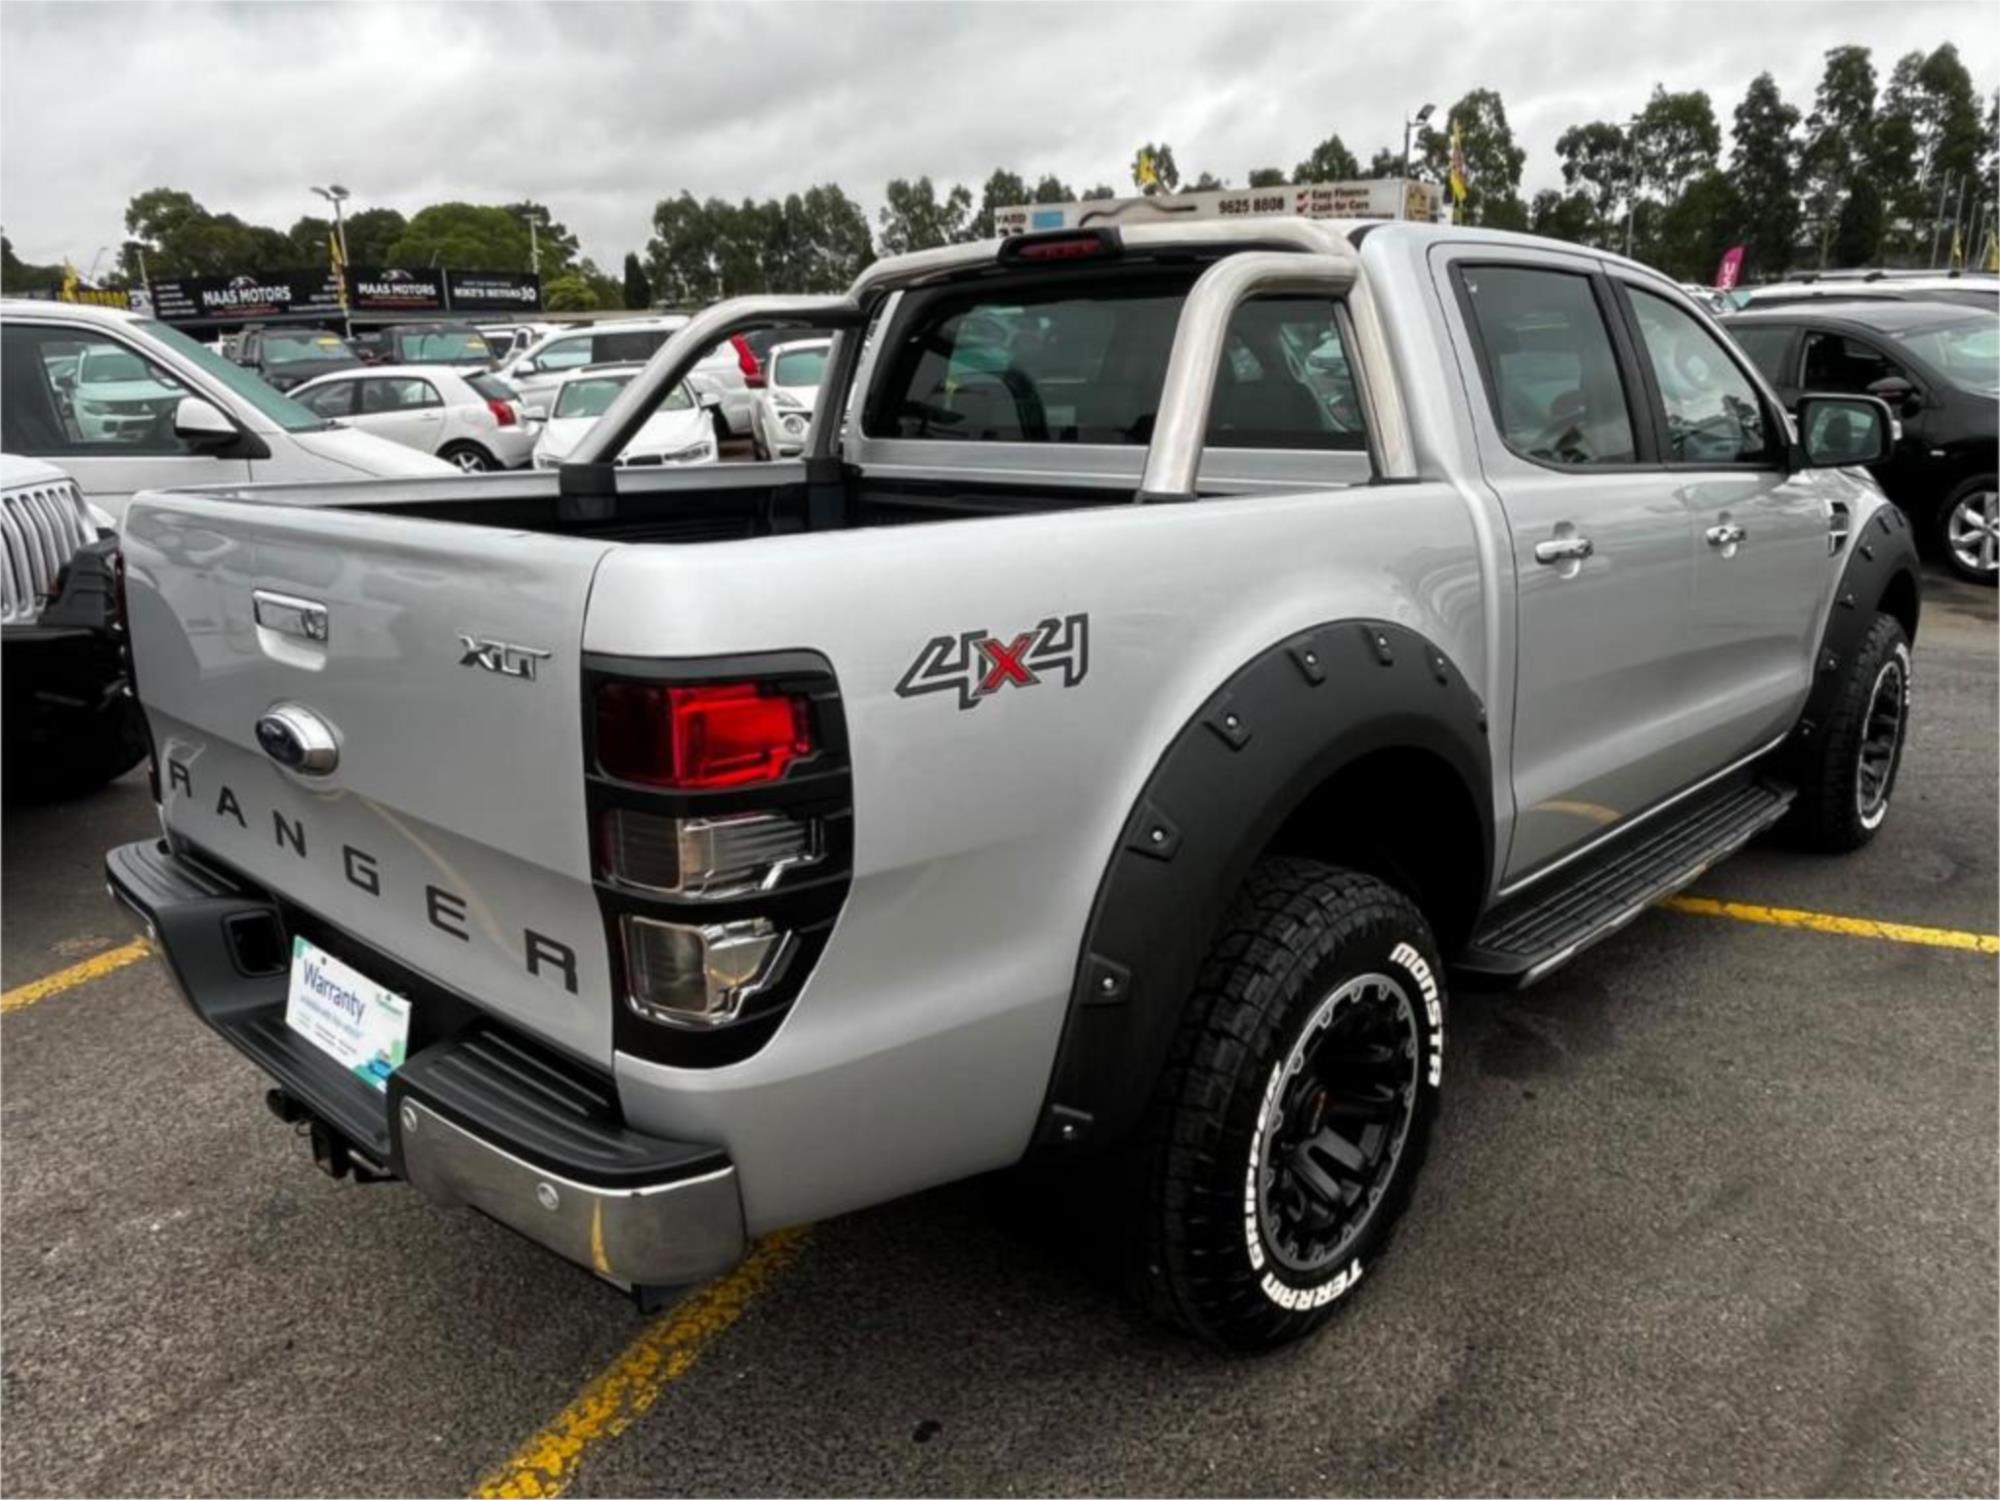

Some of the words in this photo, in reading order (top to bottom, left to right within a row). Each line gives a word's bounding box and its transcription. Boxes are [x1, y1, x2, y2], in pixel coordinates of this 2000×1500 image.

[1334, 187, 1370, 198] Finance
[202, 289, 238, 306] MAAS
[239, 285, 292, 305] MOTORS
[357, 283, 391, 297] MAAS
[392, 283, 437, 296] MOTORS
[458, 633, 553, 681] XLT
[168, 758, 579, 996] RANGER
[303, 958, 368, 1026] Warranty
[1388, 941, 1444, 1088] MONSTA
